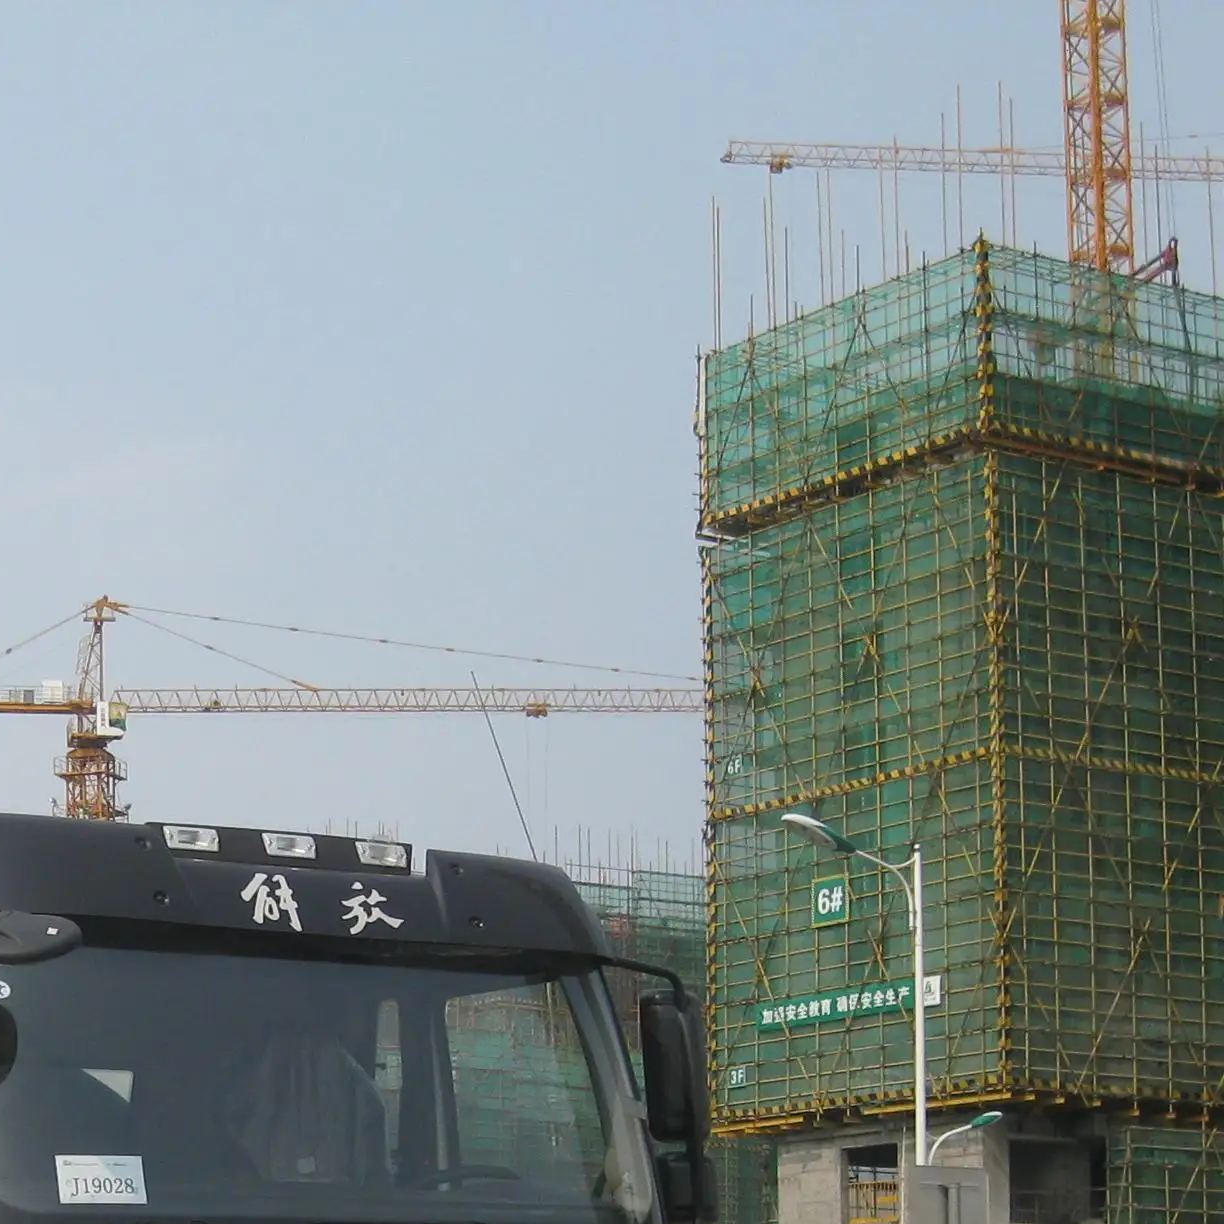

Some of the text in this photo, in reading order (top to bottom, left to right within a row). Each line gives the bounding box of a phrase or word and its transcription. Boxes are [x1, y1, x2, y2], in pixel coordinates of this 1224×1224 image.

[240, 873, 405, 935] 解放
[817, 885, 843, 915] 6#
[730, 1069, 745, 1085] 3F
[71, 1177, 135, 1197] J19028
